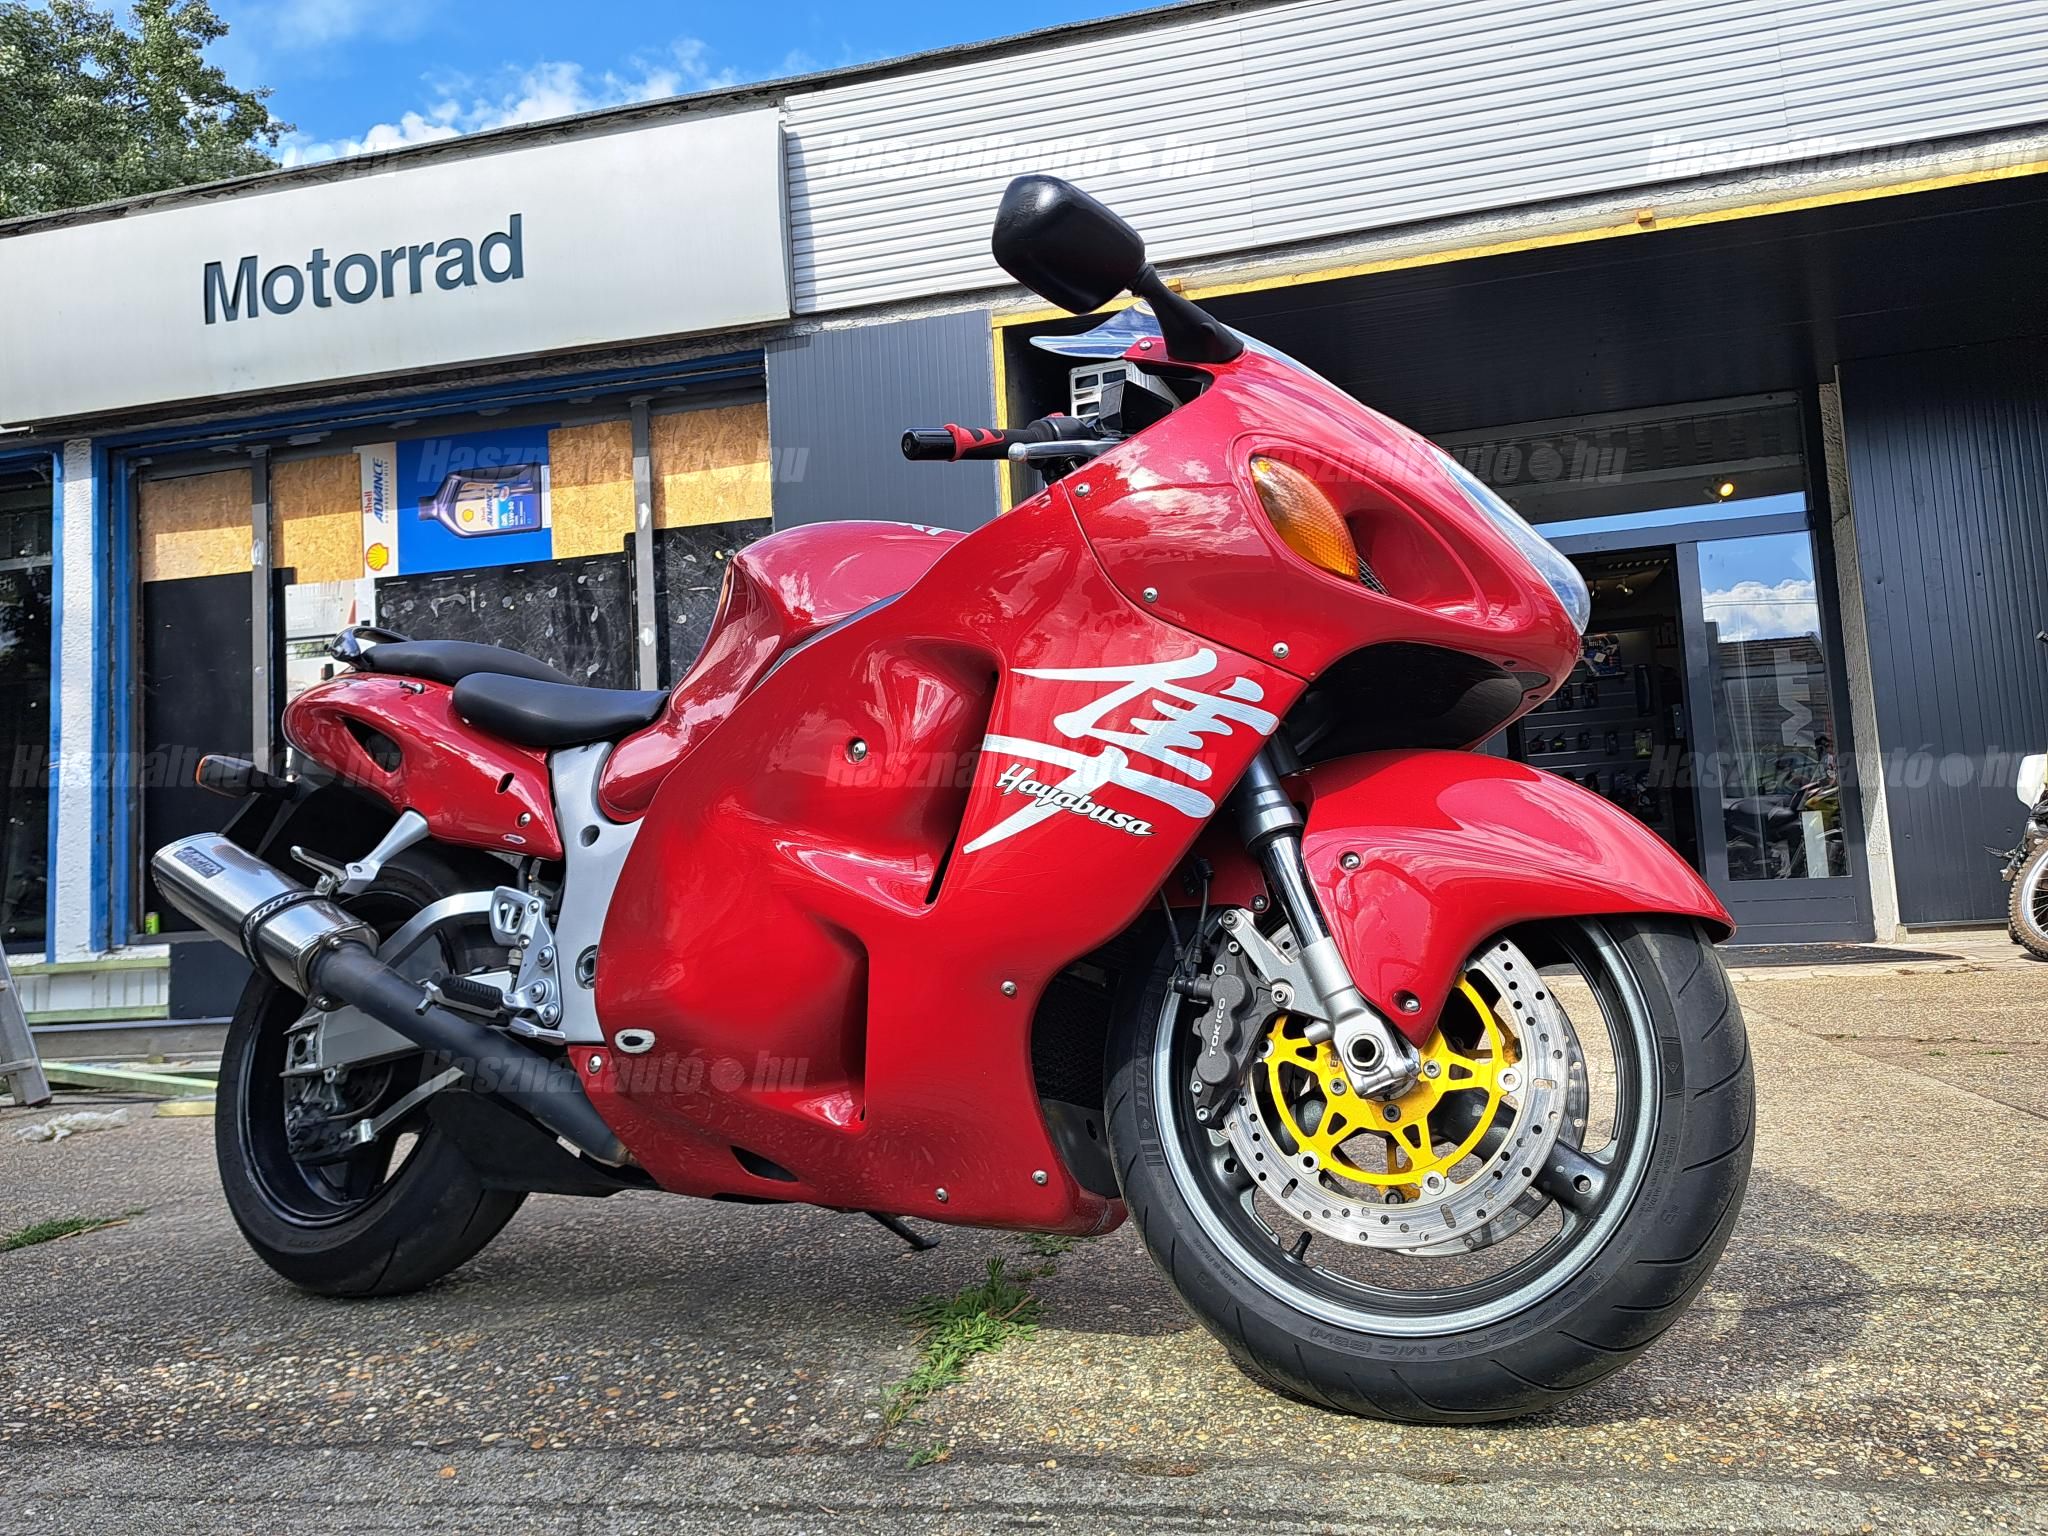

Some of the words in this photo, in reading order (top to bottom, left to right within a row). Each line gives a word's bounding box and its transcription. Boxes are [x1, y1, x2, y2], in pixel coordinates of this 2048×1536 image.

[203, 213, 525, 325] Motorrad
[364, 490, 372, 514] Shell
[373, 456, 384, 524] ADVANCE
[994, 762, 1160, 836] Hayabusa
[1208, 997, 1226, 1057] TOKICO
